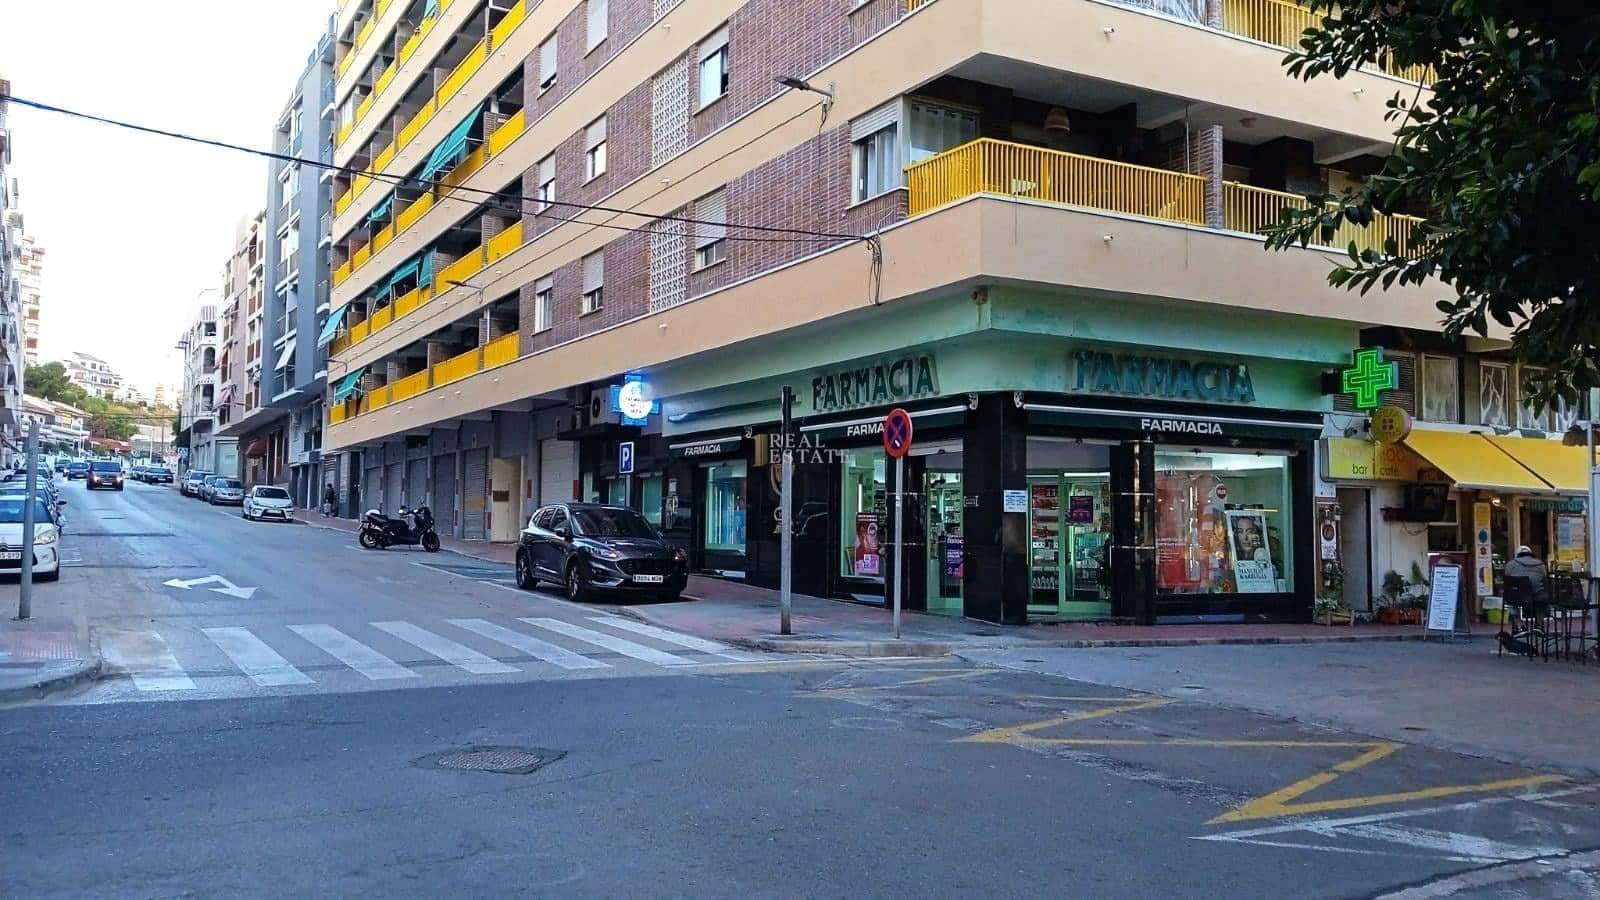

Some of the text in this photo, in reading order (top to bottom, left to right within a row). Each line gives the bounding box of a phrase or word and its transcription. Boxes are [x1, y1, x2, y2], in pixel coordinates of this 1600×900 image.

[812, 357, 938, 411] FARMACIA
[1073, 350, 1256, 402] FARMACIA
[847, 423, 885, 437] FARMA
[1141, 418, 1223, 435] FARMACIA
[622, 448, 630, 468] P
[684, 444, 721, 456] FARMACIA
[1352, 464, 1368, 475] bar
